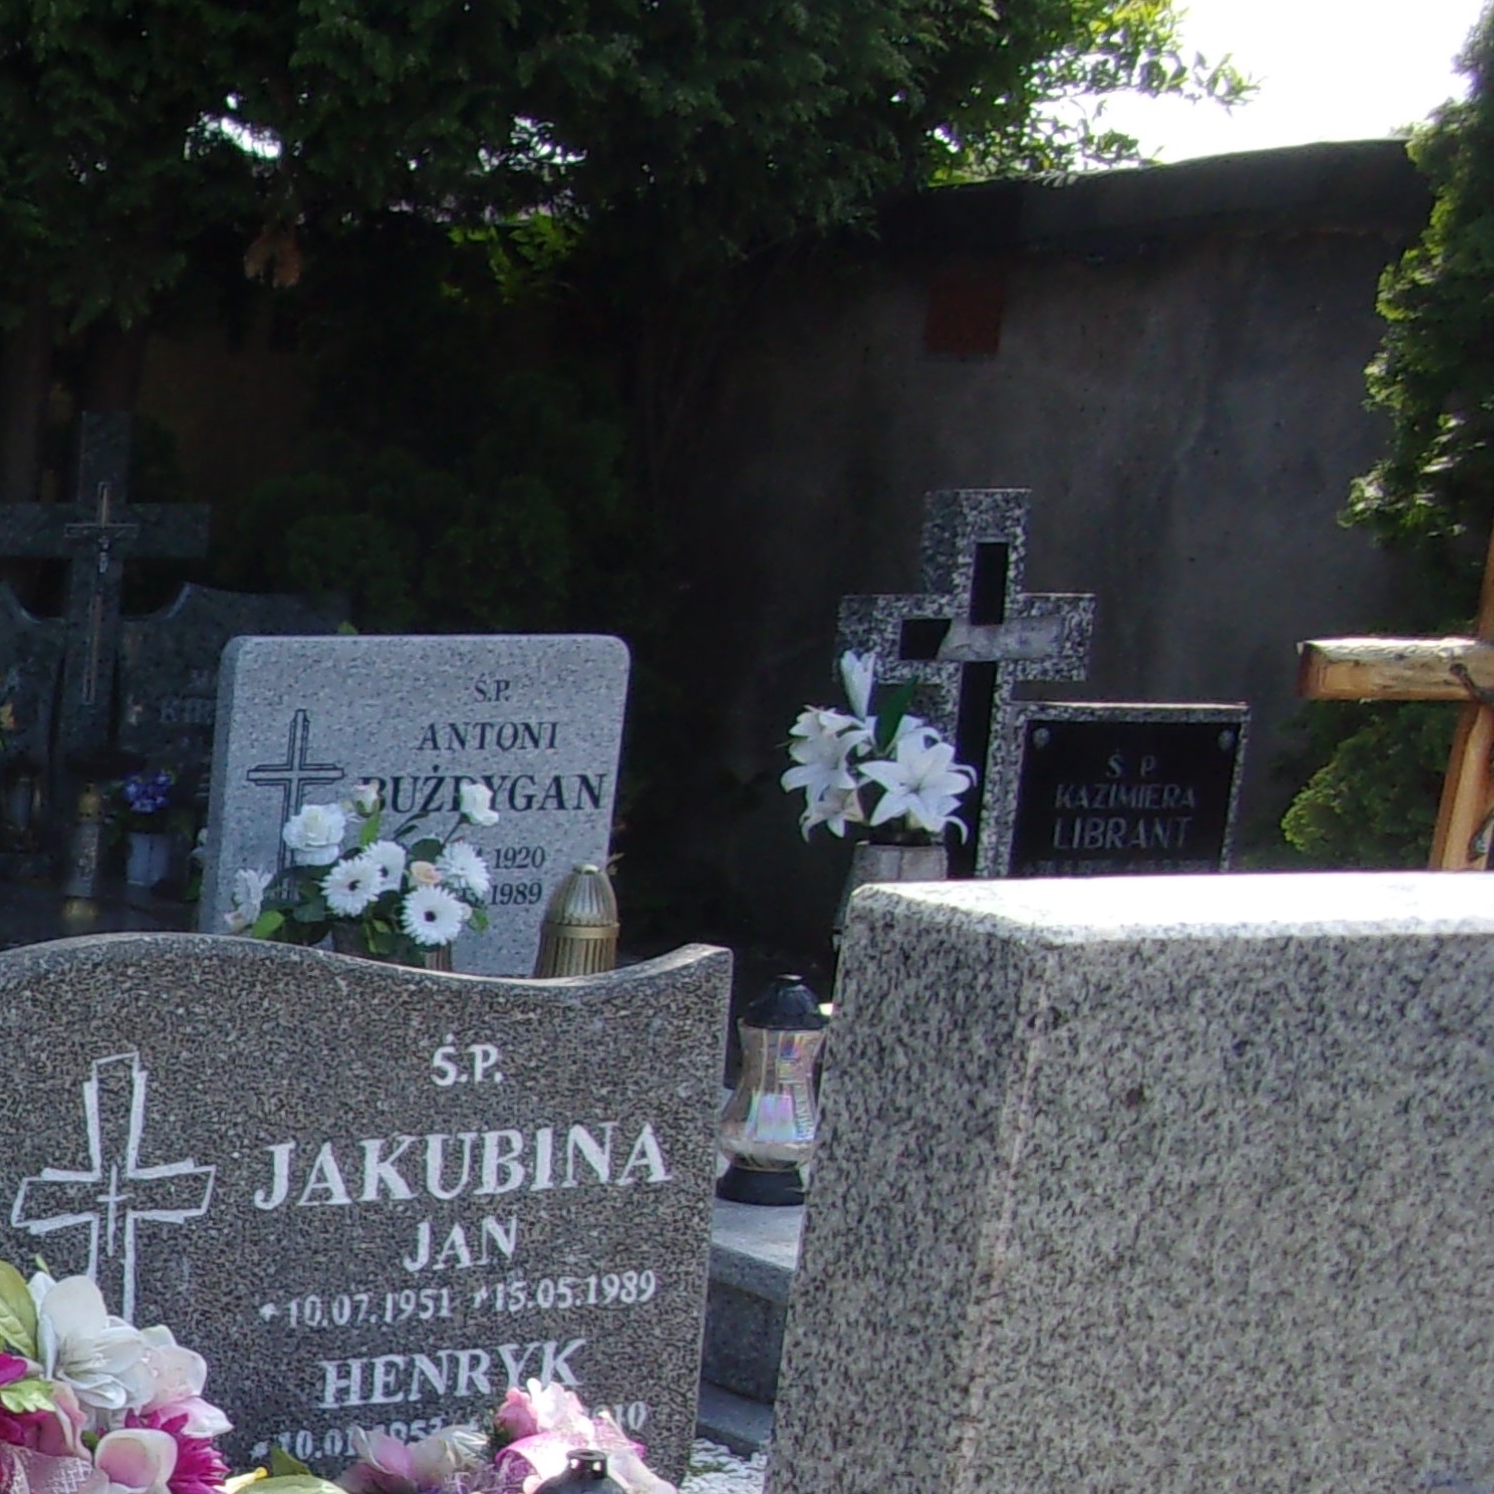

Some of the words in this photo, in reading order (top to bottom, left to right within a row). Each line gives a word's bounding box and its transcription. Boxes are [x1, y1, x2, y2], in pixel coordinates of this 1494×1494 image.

[413, 721, 560, 751] ANTONI
[1054, 783, 1197, 810] KAZIMIERA
[1052, 816, 1193, 850] LIBRANT
[493, 846, 546, 870] 1920
[489, 881, 543, 905] 1989
[253, 1120, 674, 1211] JAKUBINA
[402, 1213, 518, 1273] JAN
[317, 1338, 588, 1409] HENRYK
